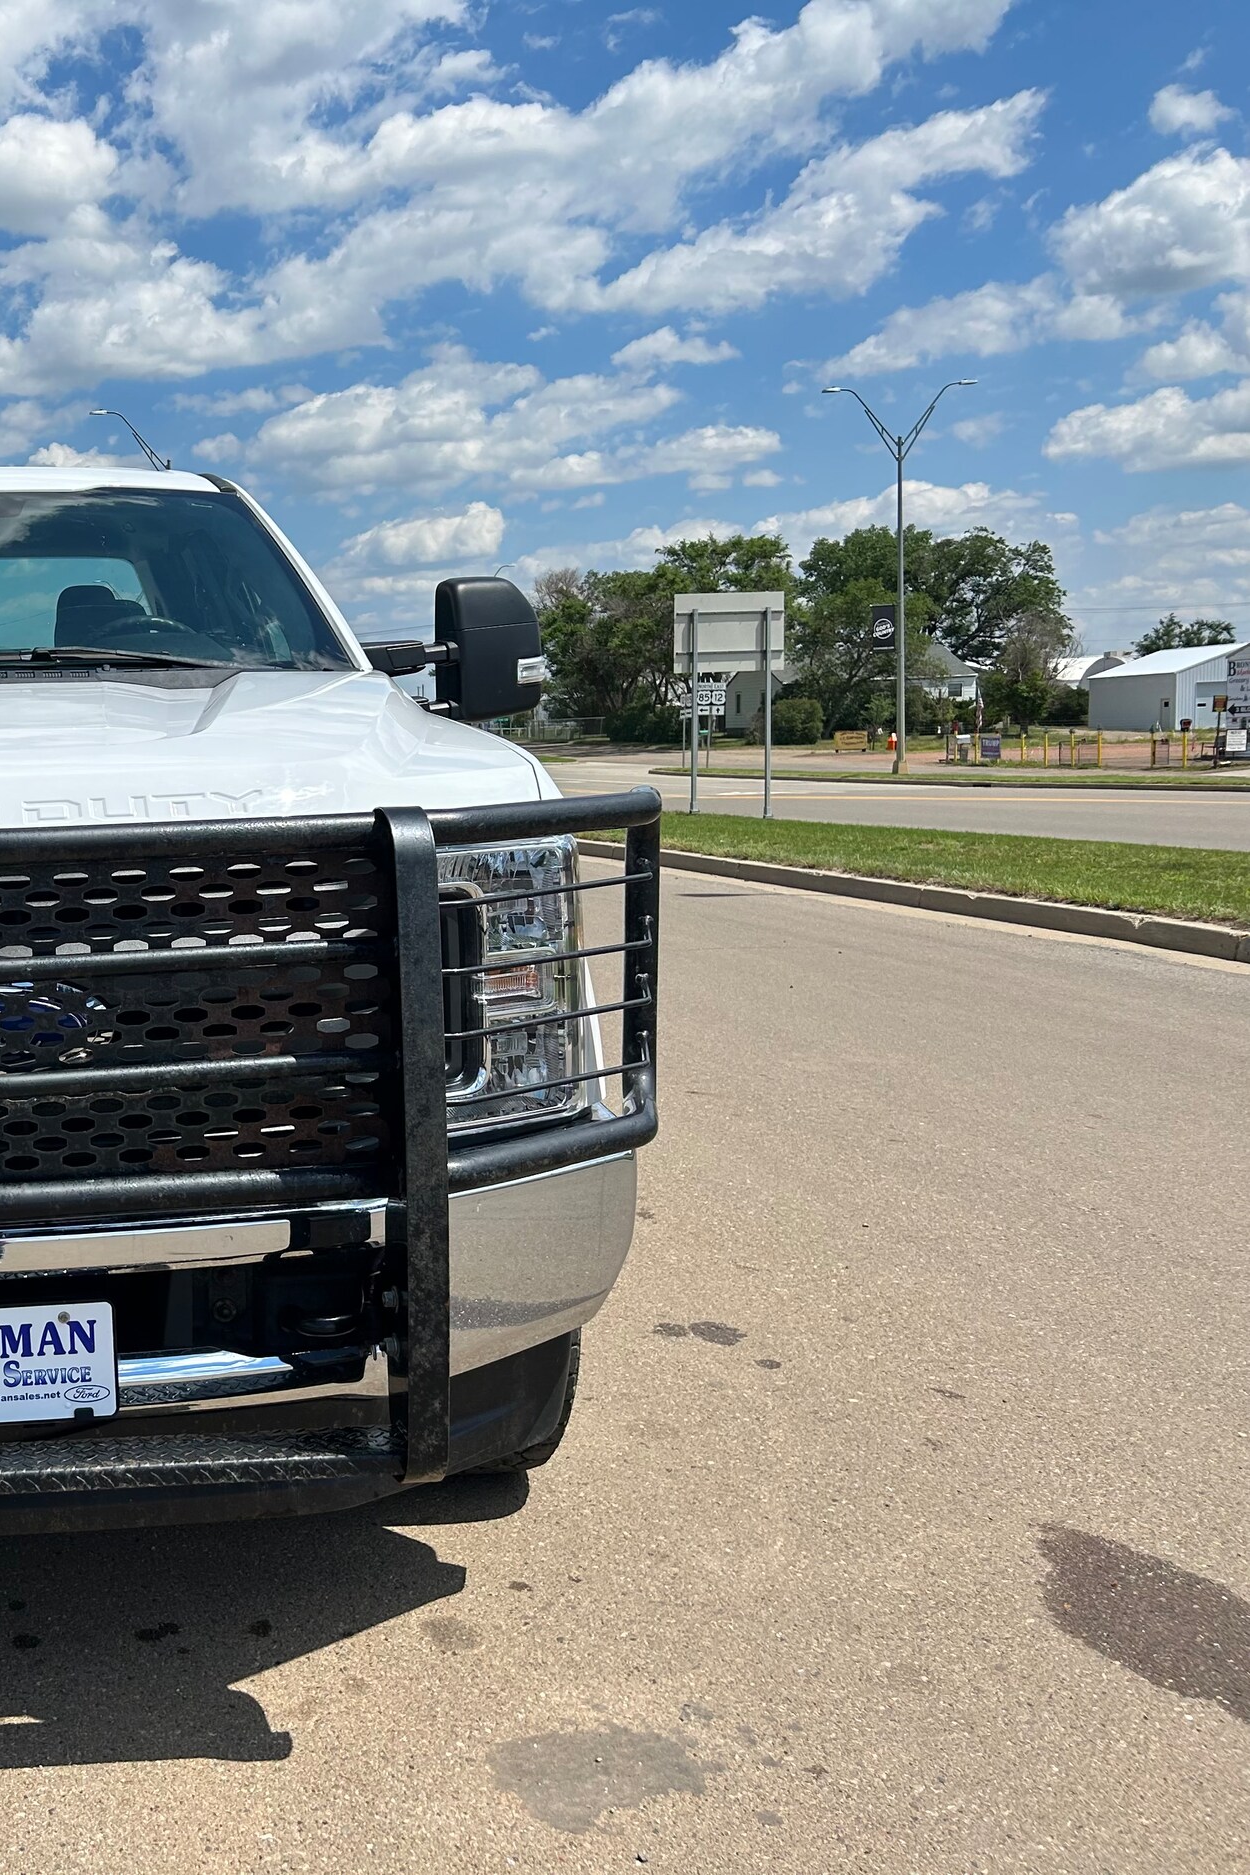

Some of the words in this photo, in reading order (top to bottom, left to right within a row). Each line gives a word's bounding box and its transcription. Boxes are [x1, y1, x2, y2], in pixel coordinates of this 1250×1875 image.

[698, 693, 710, 702] 85
[714, 693, 723, 702] 12
[982, 739, 1000, 747] TRUMP
[21, 789, 262, 823] DUTY
[3, 1360, 92, 1388] SERVICE
